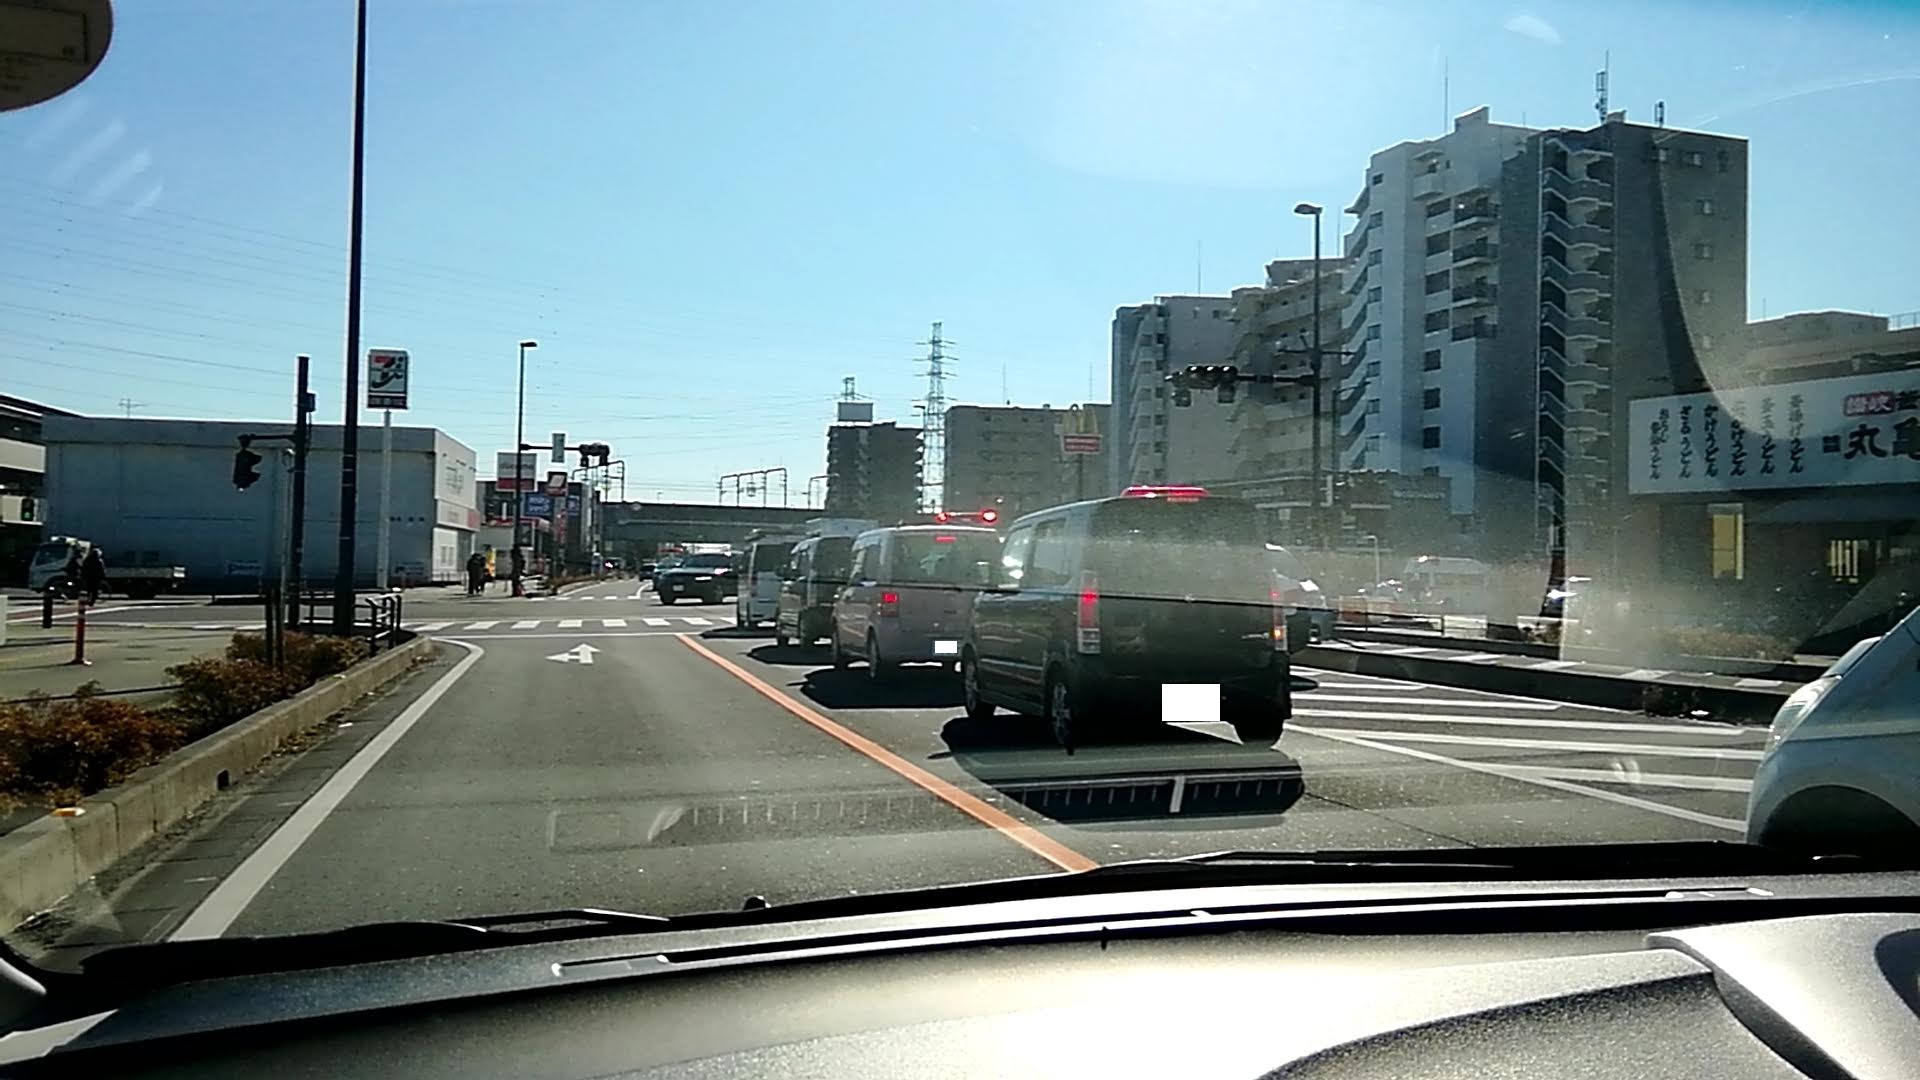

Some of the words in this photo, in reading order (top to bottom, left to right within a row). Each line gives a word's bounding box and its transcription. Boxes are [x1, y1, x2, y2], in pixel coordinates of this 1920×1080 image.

[1678, 405, 1693, 480] ざるうどん
[1703, 403, 1719, 478] かけうどん
[1730, 400, 1748, 477] かけうどん
